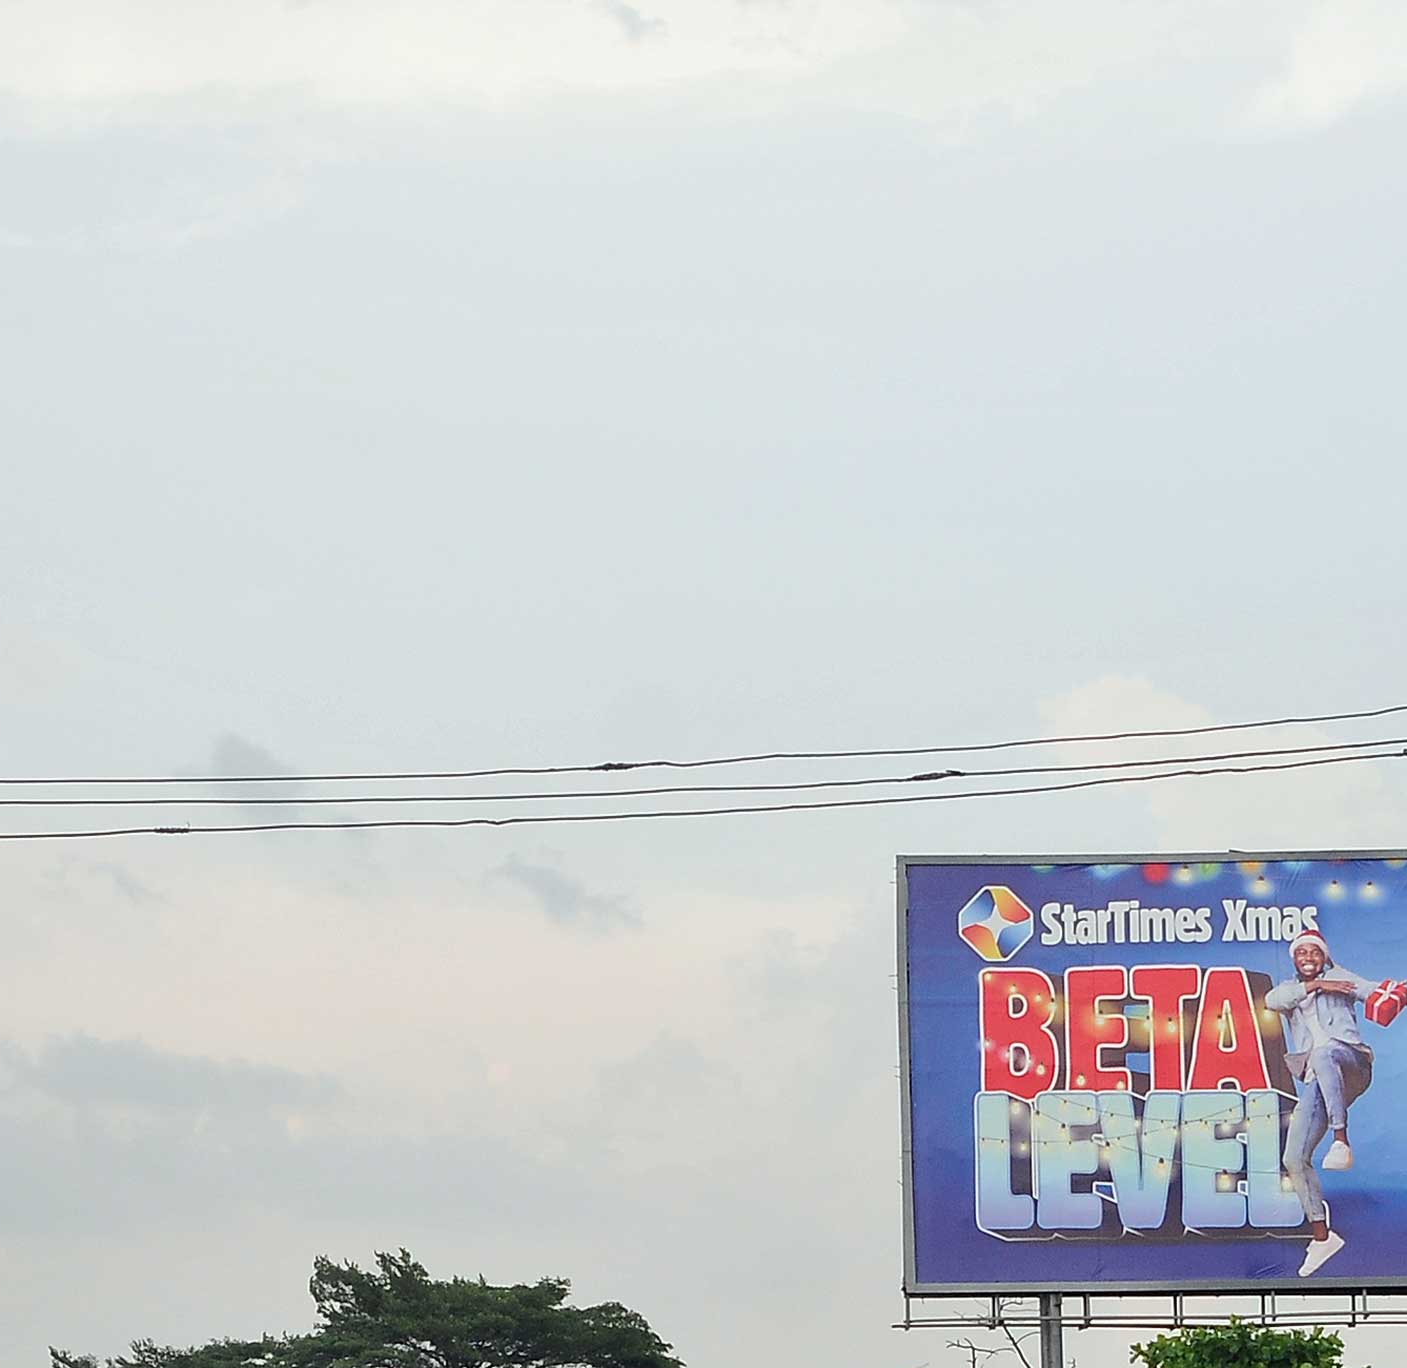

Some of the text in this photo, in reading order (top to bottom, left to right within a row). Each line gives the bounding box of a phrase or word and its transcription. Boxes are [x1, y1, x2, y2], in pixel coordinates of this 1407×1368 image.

[1040, 899, 1319, 946] StarTimes Xmas
[978, 964, 1273, 1094] BETA
[975, 1090, 1305, 1230] LEVEL
